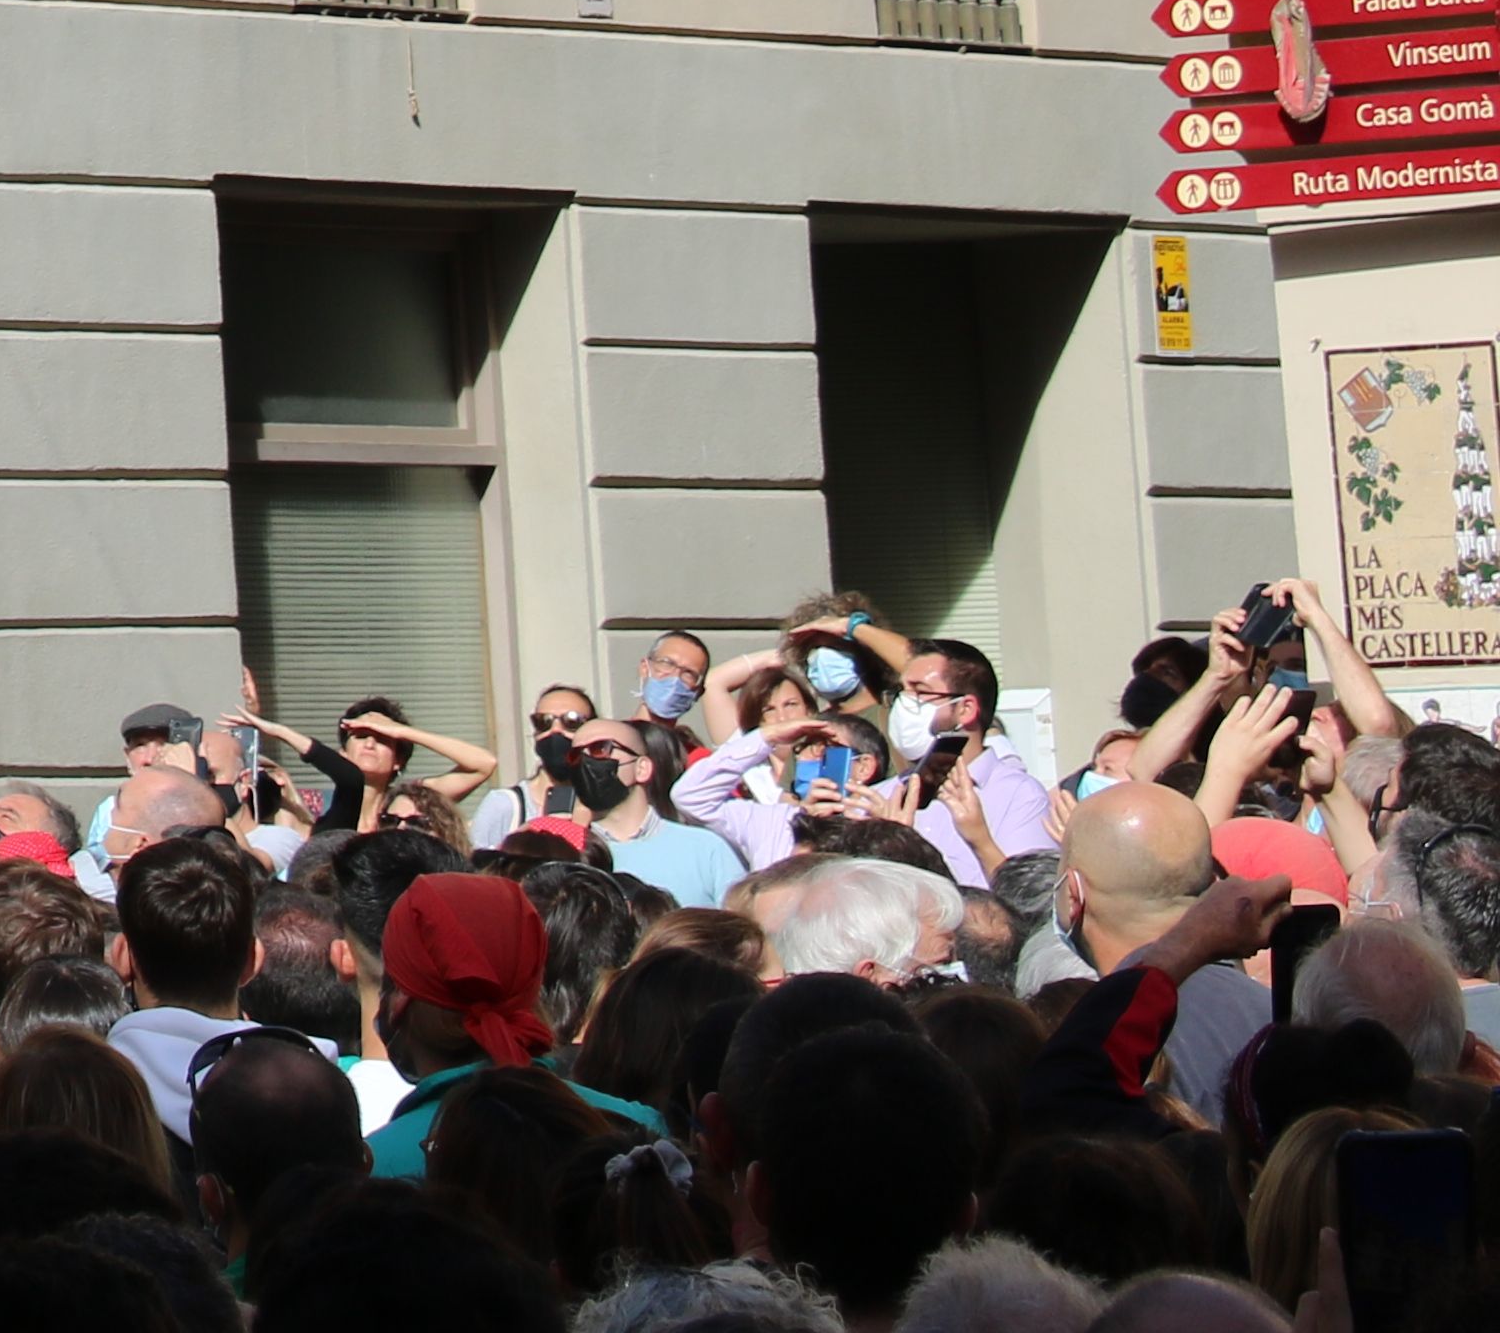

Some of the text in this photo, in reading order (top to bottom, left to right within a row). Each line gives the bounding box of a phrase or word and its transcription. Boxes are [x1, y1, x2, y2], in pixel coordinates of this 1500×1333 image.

[1387, 40, 1491, 67] Vinseum
[1356, 93, 1495, 127] Casa Gomà
[1293, 158, 1498, 196] Ruta Modernista
[1352, 545, 1382, 569] LA
[1357, 601, 1404, 631] MÉS
[1361, 630, 1500, 660] CASTELLERA
